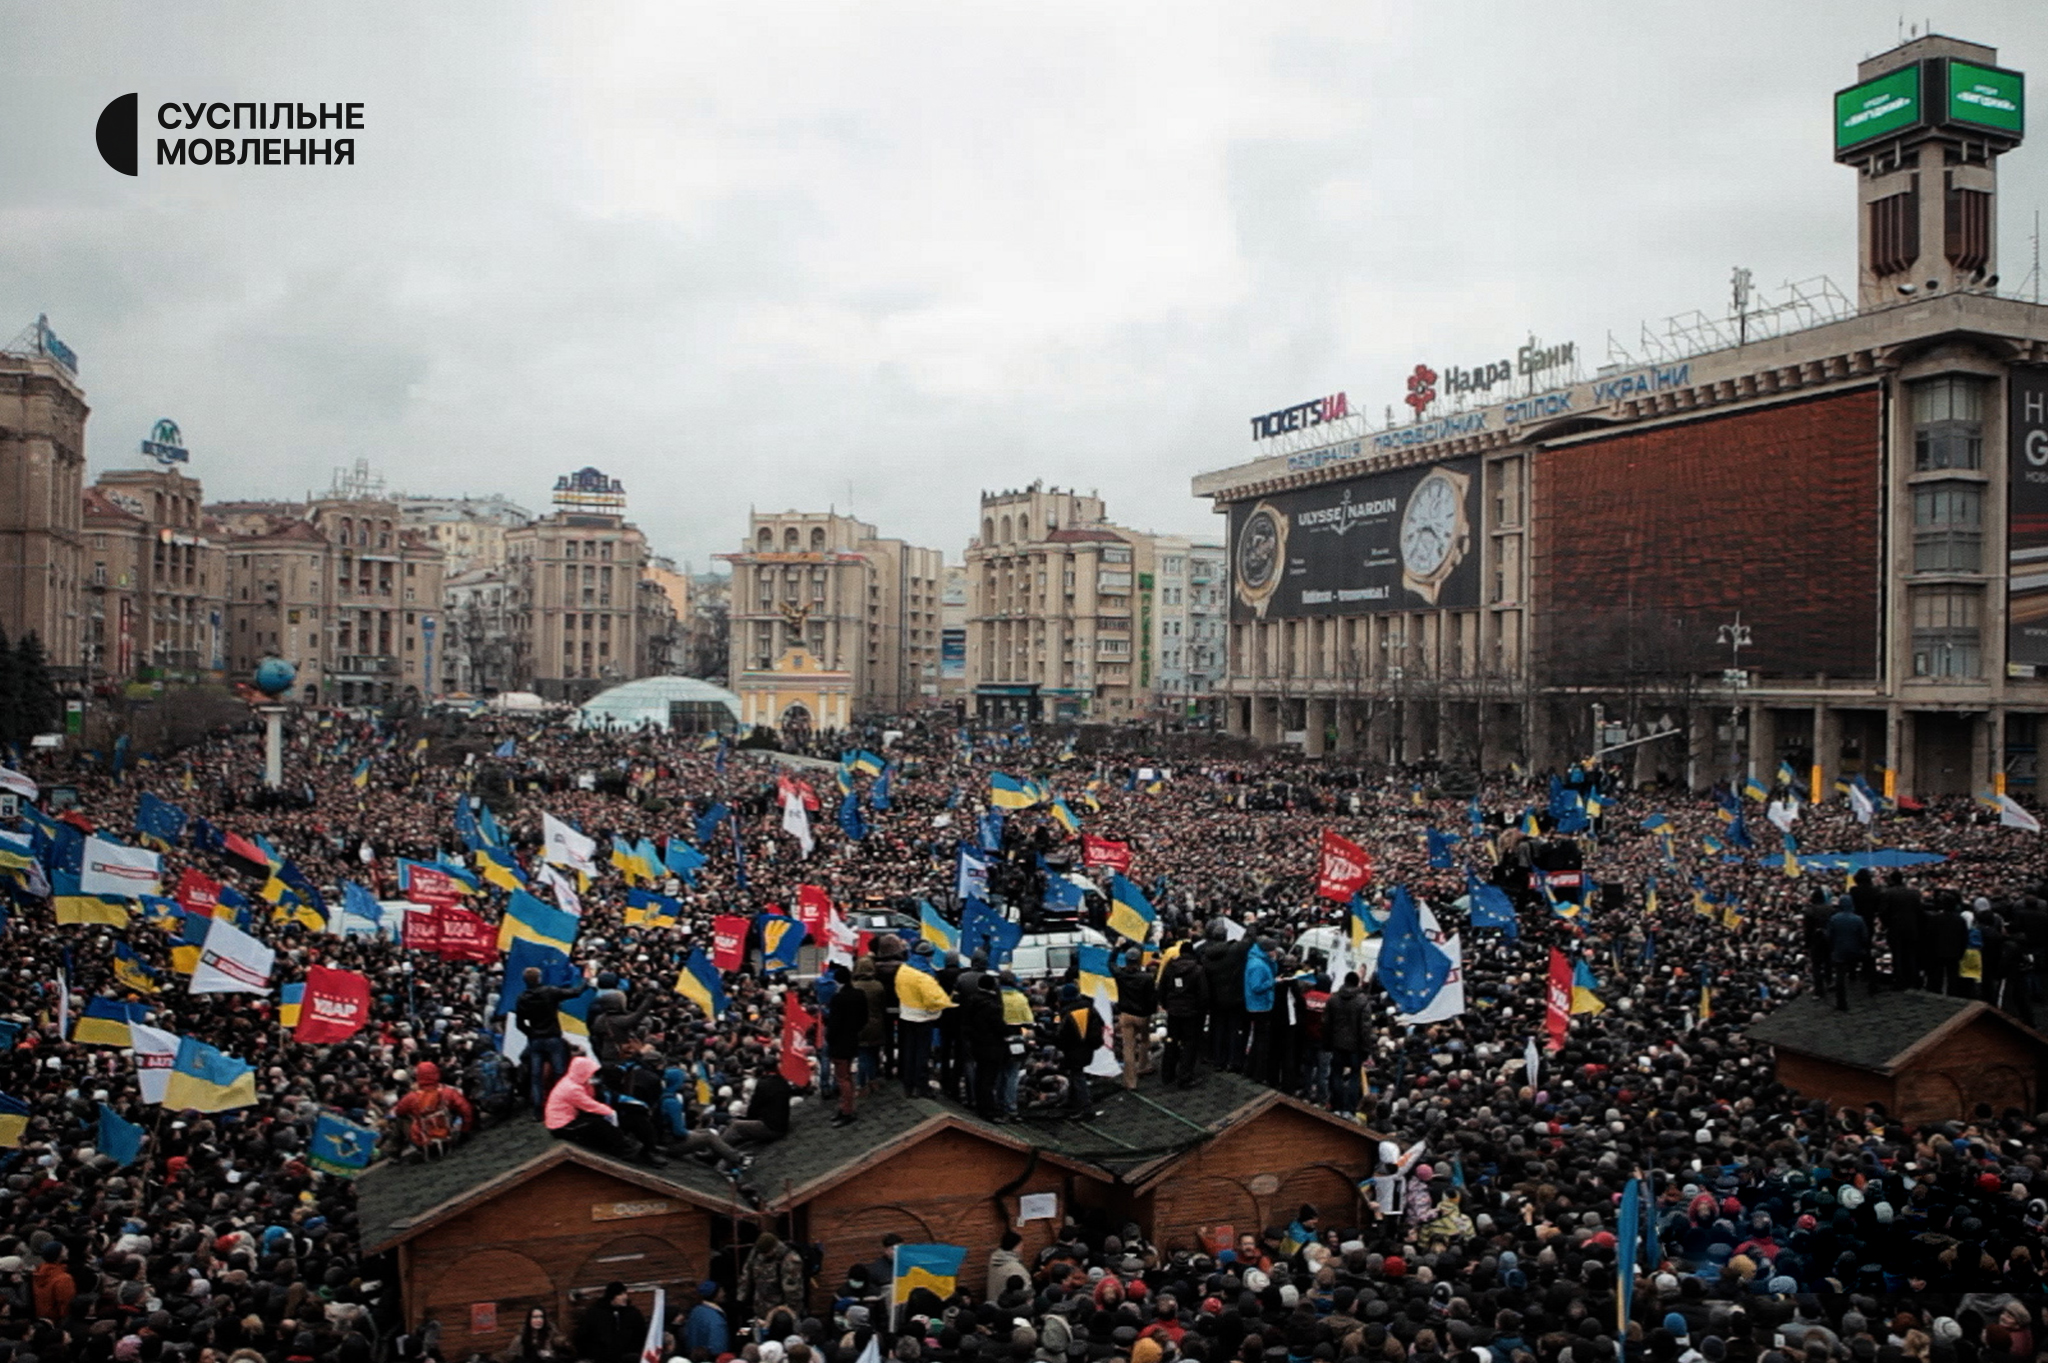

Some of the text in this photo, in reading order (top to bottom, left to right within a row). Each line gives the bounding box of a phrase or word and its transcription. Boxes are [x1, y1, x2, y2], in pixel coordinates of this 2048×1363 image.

[1444, 341, 1574, 395] Надра Банк
[1504, 391, 1571, 424] СПІЛОК
[1592, 364, 1690, 404] УКРАЇНИ
[1298, 498, 1397, 526] ULYSSE NARDIN
[313, 997, 359, 1019] УДАР
